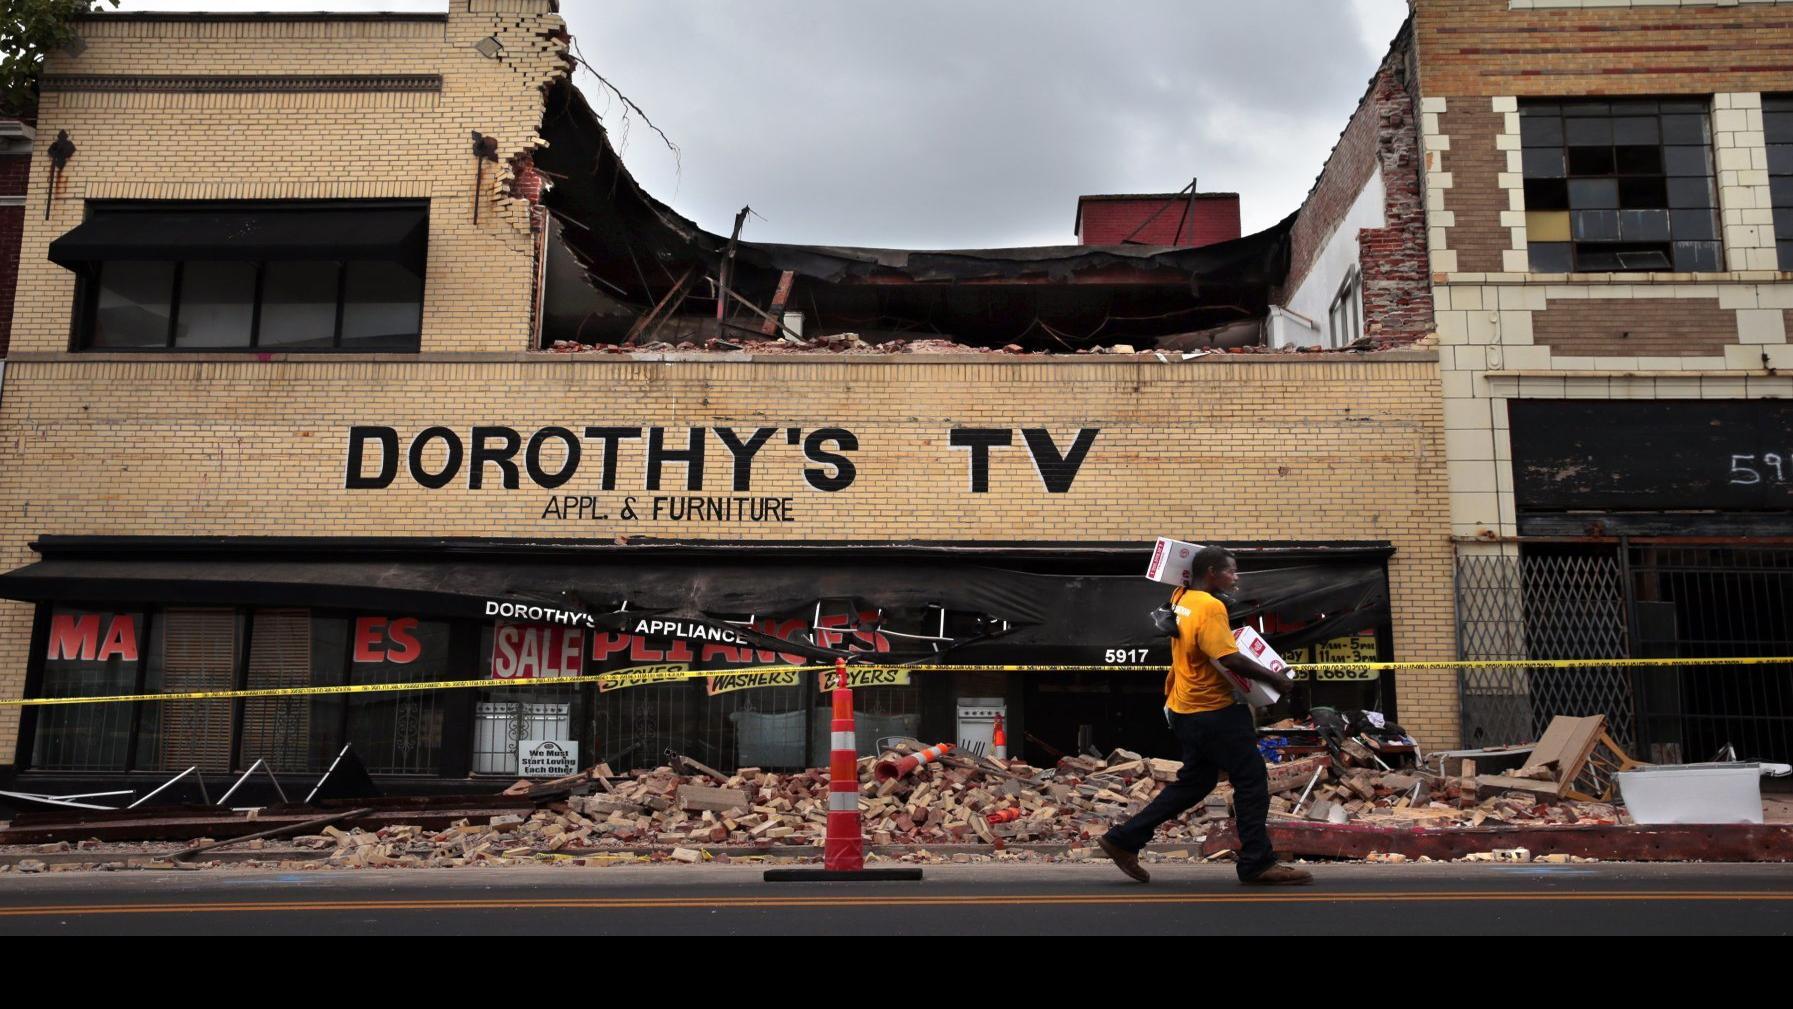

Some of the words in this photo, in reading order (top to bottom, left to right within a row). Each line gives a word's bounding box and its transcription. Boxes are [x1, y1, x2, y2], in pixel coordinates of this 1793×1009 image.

[344, 425, 859, 493] DOROTHY'S
[947, 427, 1101, 494] TV
[1730, 452, 1793, 484] 59
[541, 495, 609, 520] APPL.
[620, 496, 639, 521] &
[652, 496, 795, 522] FURNITURE
[47, 613, 140, 662] MA
[353, 616, 423, 664] ES
[495, 626, 582, 678] SALE
[1105, 648, 1149, 664] 5917
[711, 669, 798, 692] WASHERS
[824, 669, 899, 689] DYERS
[546, 758, 576, 766] Loving
[548, 766, 573, 774] Other
